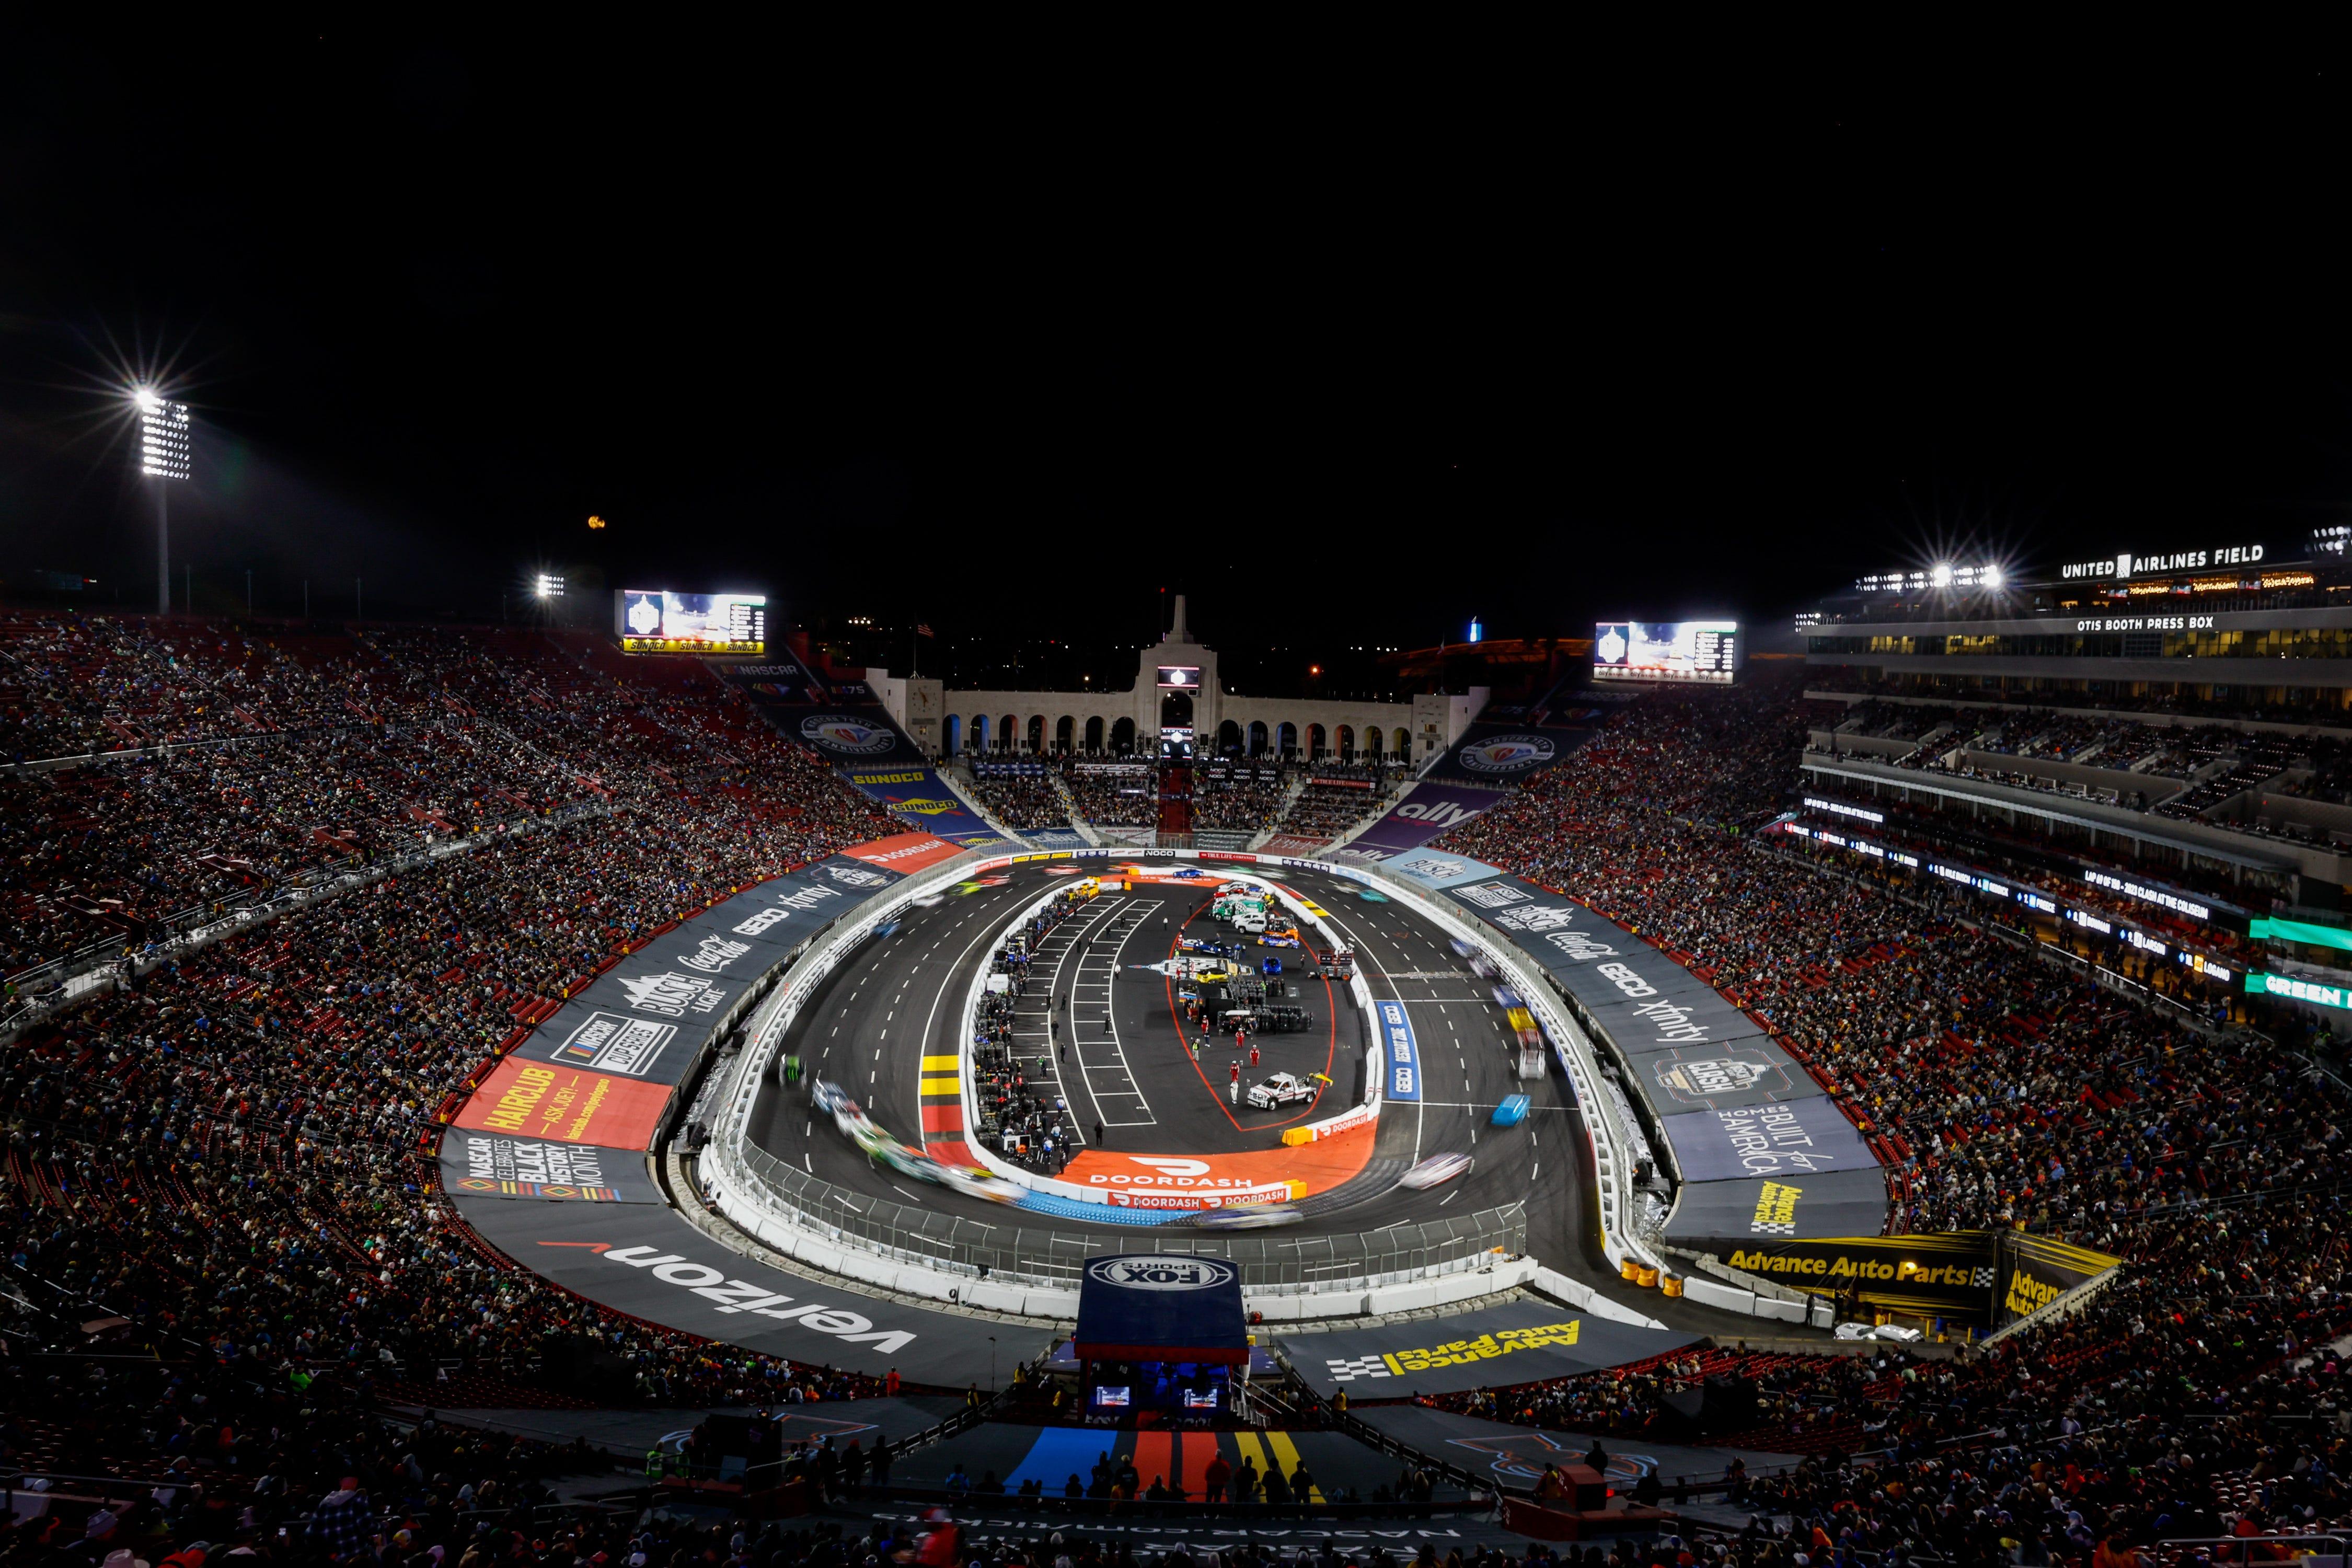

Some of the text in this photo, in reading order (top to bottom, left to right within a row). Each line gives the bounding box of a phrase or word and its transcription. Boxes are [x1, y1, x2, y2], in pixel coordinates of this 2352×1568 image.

[2062, 545, 2264, 578] UNITED AIRLINES FIELD
[2078, 616, 2214, 631] OTIS BOOTH PRESS BOX
[740, 665, 799, 675] NASCAR
[848, 686, 864, 694] 75
[807, 717, 840, 727] NASCAR
[822, 737, 890, 753] ANNIVERSARY
[1485, 736, 1530, 745] NASCAR
[853, 771, 925, 784] SUNOCO
[1466, 756, 1532, 770] ANNIVERSARY
[896, 801, 955, 812] SUNOCO
[1397, 802, 1481, 827] ally
[882, 839, 945, 860] DOORDASH
[1403, 859, 1463, 879] BUSCH
[777, 884, 842, 909] xfinity
[2085, 870, 2096, 883] LAP
[2103, 875, 2111, 887] OF
[2124, 882, 2137, 896] 2023
[2137, 886, 2157, 903] CLASH
[2157, 893, 2165, 905] AT
[2165, 895, 2177, 909] THE
[2177, 899, 2208, 920] COLISEUM
[732, 908, 790, 936] GEICO
[1503, 905, 1568, 931] BUSCH
[2036, 898, 2055, 914] PREECE
[2086, 916, 2111, 933] BOWMAN
[2142, 938, 2165, 955] LARSON
[2204, 961, 2230, 981] LOGANO
[632, 972, 712, 1016] BUSCH
[1597, 963, 1657, 997] GEICO
[2266, 975, 2341, 1006] GREEN
[693, 988, 725, 1013] LIGHT
[577, 1020, 618, 1048] NASCAR
[1632, 999, 1710, 1042] xfinity
[607, 1028, 654, 1065] CUP SERIES
[1384, 1006, 1413, 1092] GEICO RESTART ZONE GEICO
[1688, 1062, 1735, 1092] CLASH
[483, 1065, 556, 1130] HAIRCLUB
[541, 1087, 579, 1124] ASK JOEY!
[1719, 1105, 1789, 1118] HOMES
[1333, 1114, 1368, 1133] DOORDASH
[1761, 1113, 1813, 1146] BUILT
[468, 1137, 494, 1179] NASCAR
[493, 1139, 515, 1180] CELEBRATES
[1721, 1118, 1782, 1175] AMERICA
[514, 1141, 548, 1183] BLACK
[545, 1143, 573, 1185] HISTORY
[568, 1145, 605, 1187] MONTH
[1090, 1175, 1252, 1187] DOORDASH
[1134, 1195, 1200, 1208] DOORDASH
[1225, 1190, 1284, 1206] DOORDASH
[1754, 1181, 1781, 1221] Auto Parts
[1774, 1185, 1802, 1221] Advance
[1123, 1270, 1200, 1284] FOX
[1728, 1250, 1969, 1286] Advance Auto Parts
[603, 1246, 917, 1354] verizon
[2005, 1290, 2035, 1316] Auto
[1396, 1320, 1579, 1361] Auto Parts
[1404, 1331, 1579, 1370] Advance
